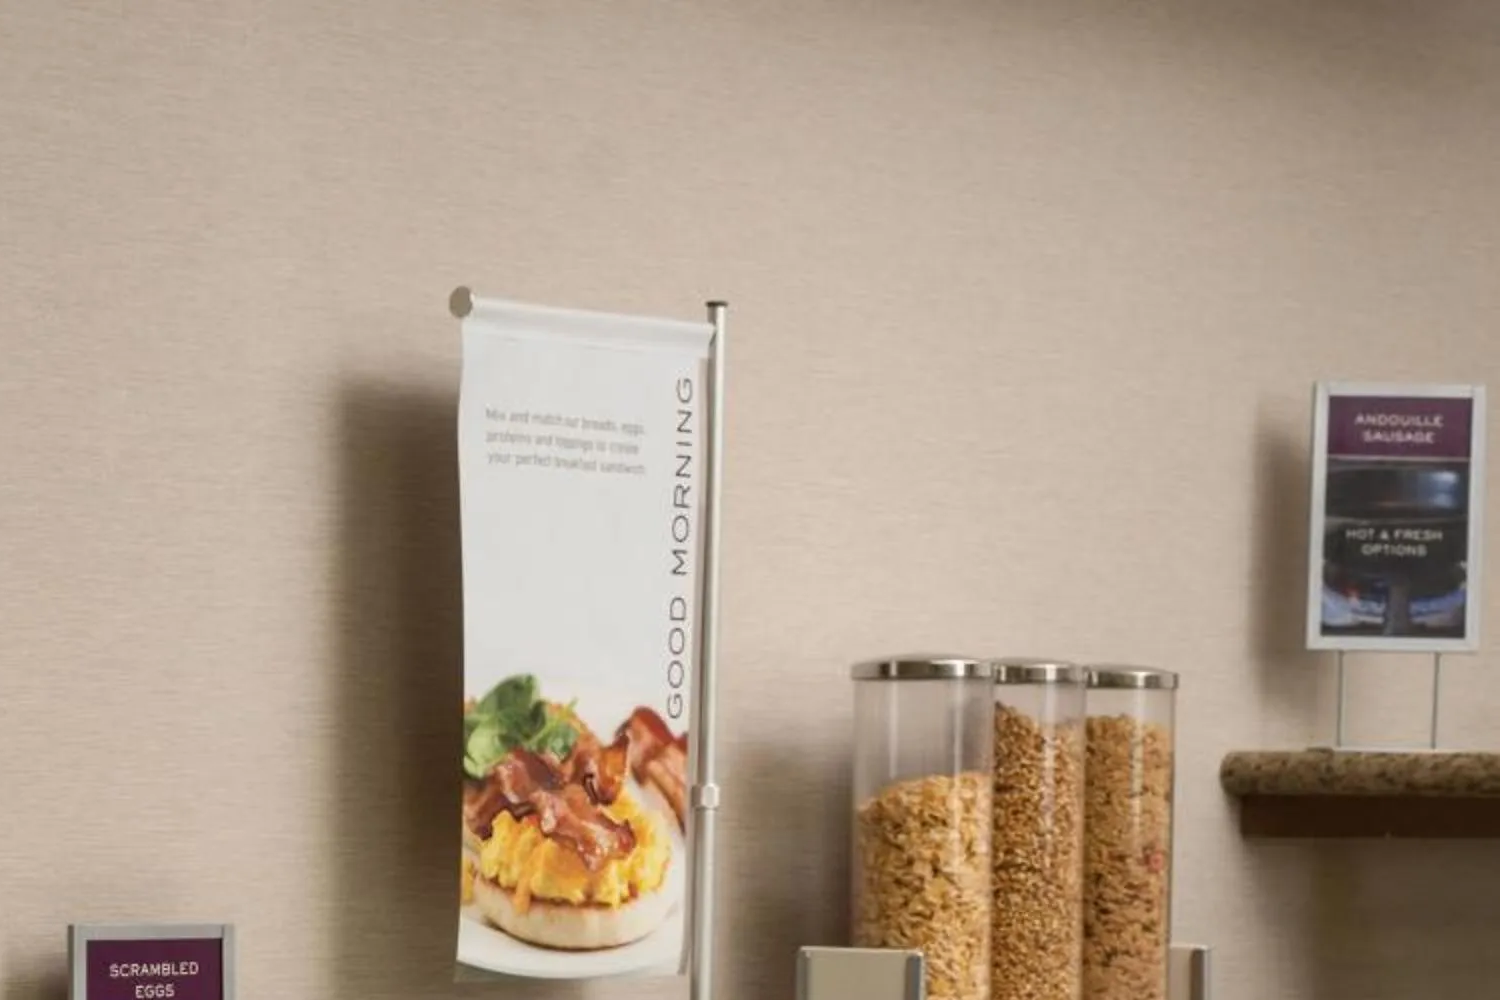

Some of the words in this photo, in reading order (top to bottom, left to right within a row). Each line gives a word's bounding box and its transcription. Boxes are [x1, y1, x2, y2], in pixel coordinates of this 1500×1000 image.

[1355, 413, 1444, 427] ANDOUILLE
[1362, 431, 1434, 443] SAUSAGE
[670, 376, 693, 576] MORNING
[1345, 528, 1374, 540] HOT
[1393, 529, 1443, 541] FRESH
[1361, 544, 1427, 556] OPTIONS
[667, 597, 687, 719] GOOD
[109, 962, 199, 978] SCRAMBLED
[135, 984, 175, 998] EGGS
